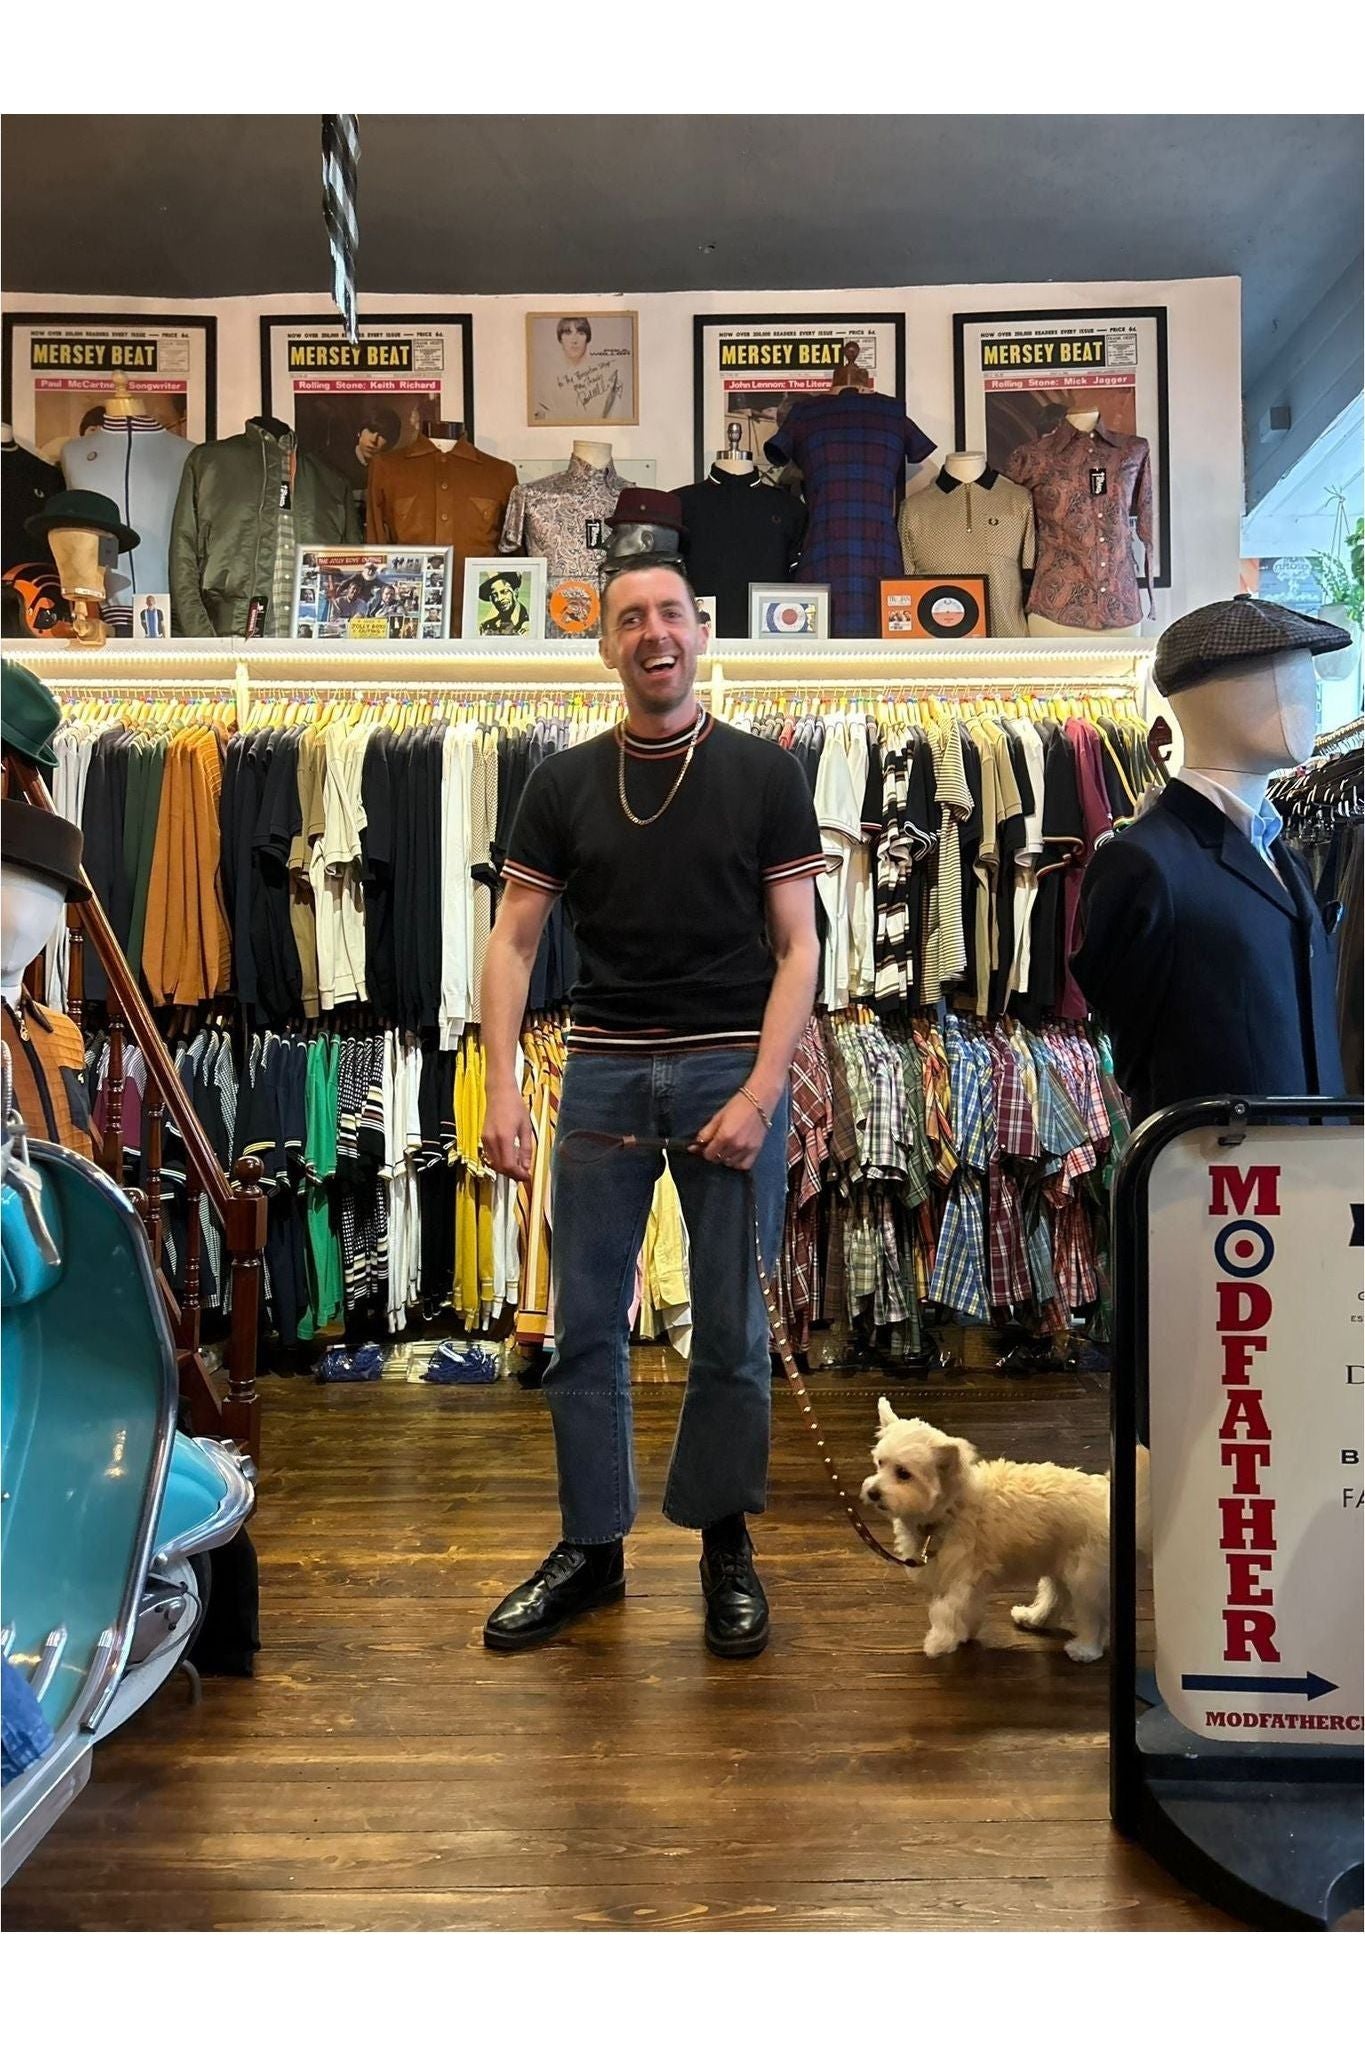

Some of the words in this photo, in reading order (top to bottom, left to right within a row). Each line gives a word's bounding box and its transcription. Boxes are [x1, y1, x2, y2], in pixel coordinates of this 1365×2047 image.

[33, 344, 106, 364] MERSEY
[111, 345, 155, 366] BEAT
[290, 346, 361, 366] MERSEY
[367, 346, 409, 365] BEAT
[721, 344, 793, 364] MERSEY
[799, 344, 842, 364] BEAT
[984, 343, 1055, 365] MERSEY
[1060, 341, 1103, 362] BEAT
[41, 379, 62, 388] Paul
[68, 380, 115, 389] McCartne
[128, 381, 181, 391] Songwriter
[299, 381, 330, 391] Rolling
[336, 381, 366, 389] Stone:
[370, 381, 395, 389] Keith
[400, 381, 436, 389] Richard
[729, 381, 751, 389] John
[752, 381, 786, 389] Lennon:
[788, 380, 804, 388] The
[806, 380, 832, 388] Litera
[992, 380, 1023, 389] Rolling
[1028, 378, 1059, 387] Stone:
[1064, 377, 1087, 386] Mick
[1093, 376, 1127, 385] Jagger
